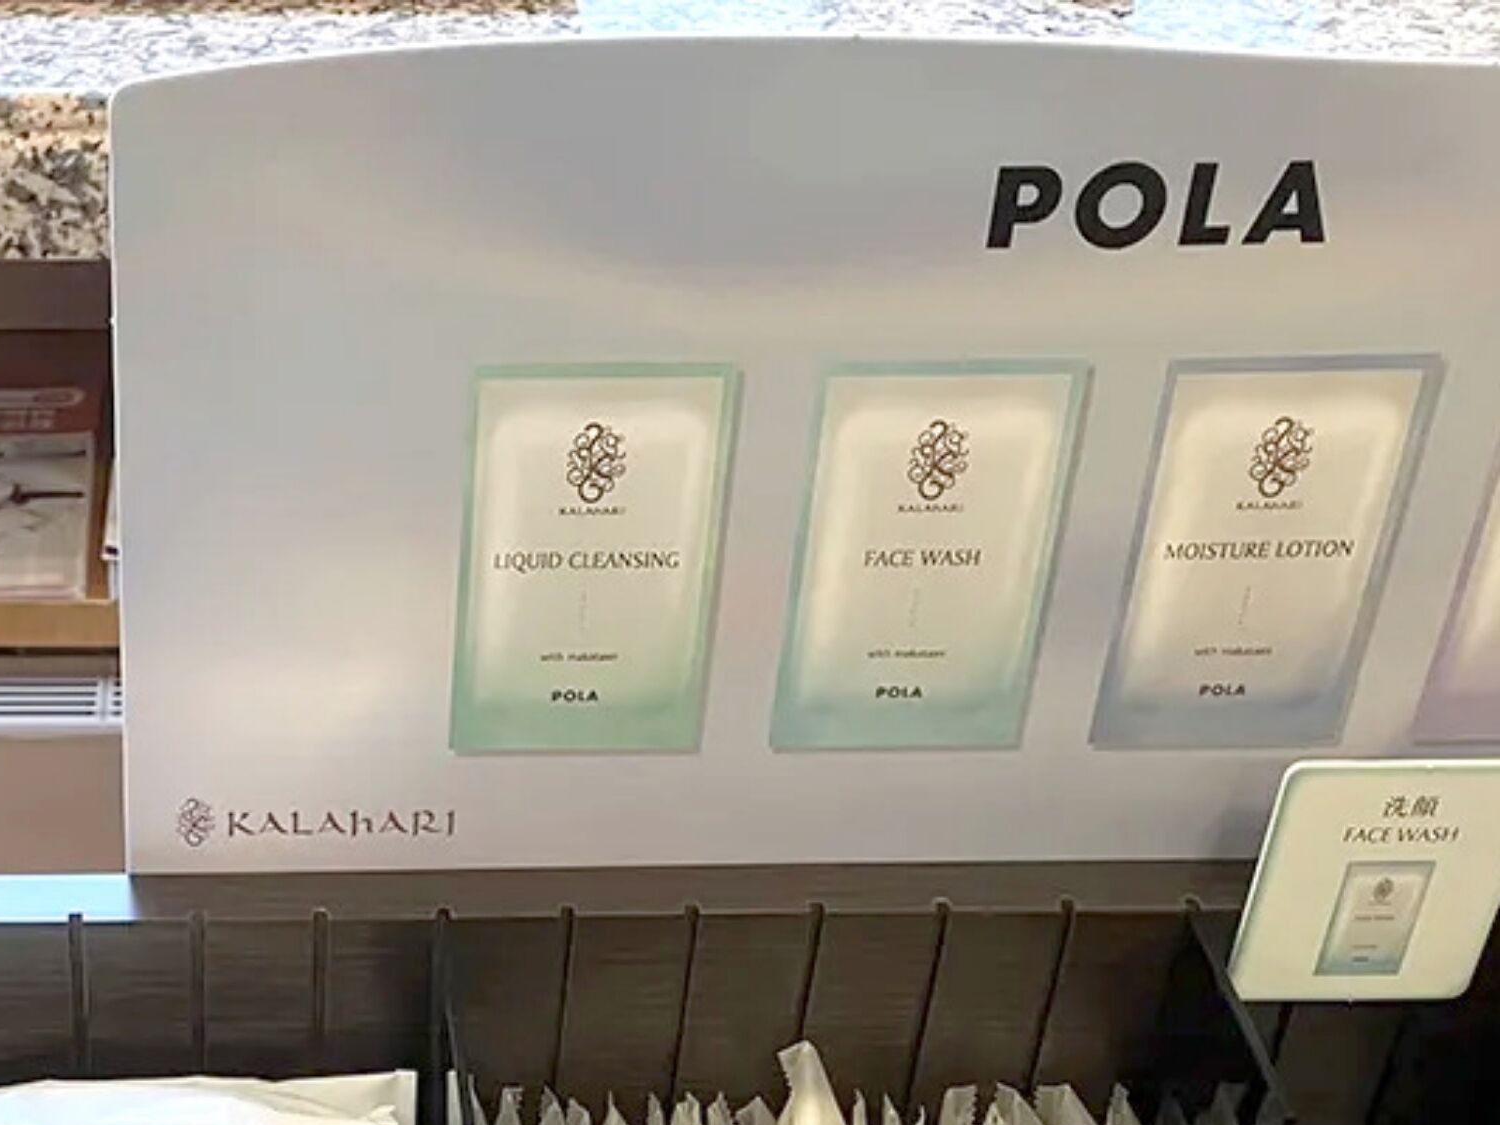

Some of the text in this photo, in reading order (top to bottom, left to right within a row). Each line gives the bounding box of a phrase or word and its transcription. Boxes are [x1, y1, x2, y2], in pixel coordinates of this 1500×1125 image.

[985, 159, 1326, 250] POLA
[1164, 539, 1355, 560] MOISTURE LOTION
[494, 551, 680, 573] LIQUID CLEANSING
[864, 549, 981, 567] FACE WASH
[552, 689, 598, 702] POLA
[876, 686, 922, 698] POLA
[1199, 684, 1246, 696] POLA
[1342, 827, 1459, 842] FACE WASH
